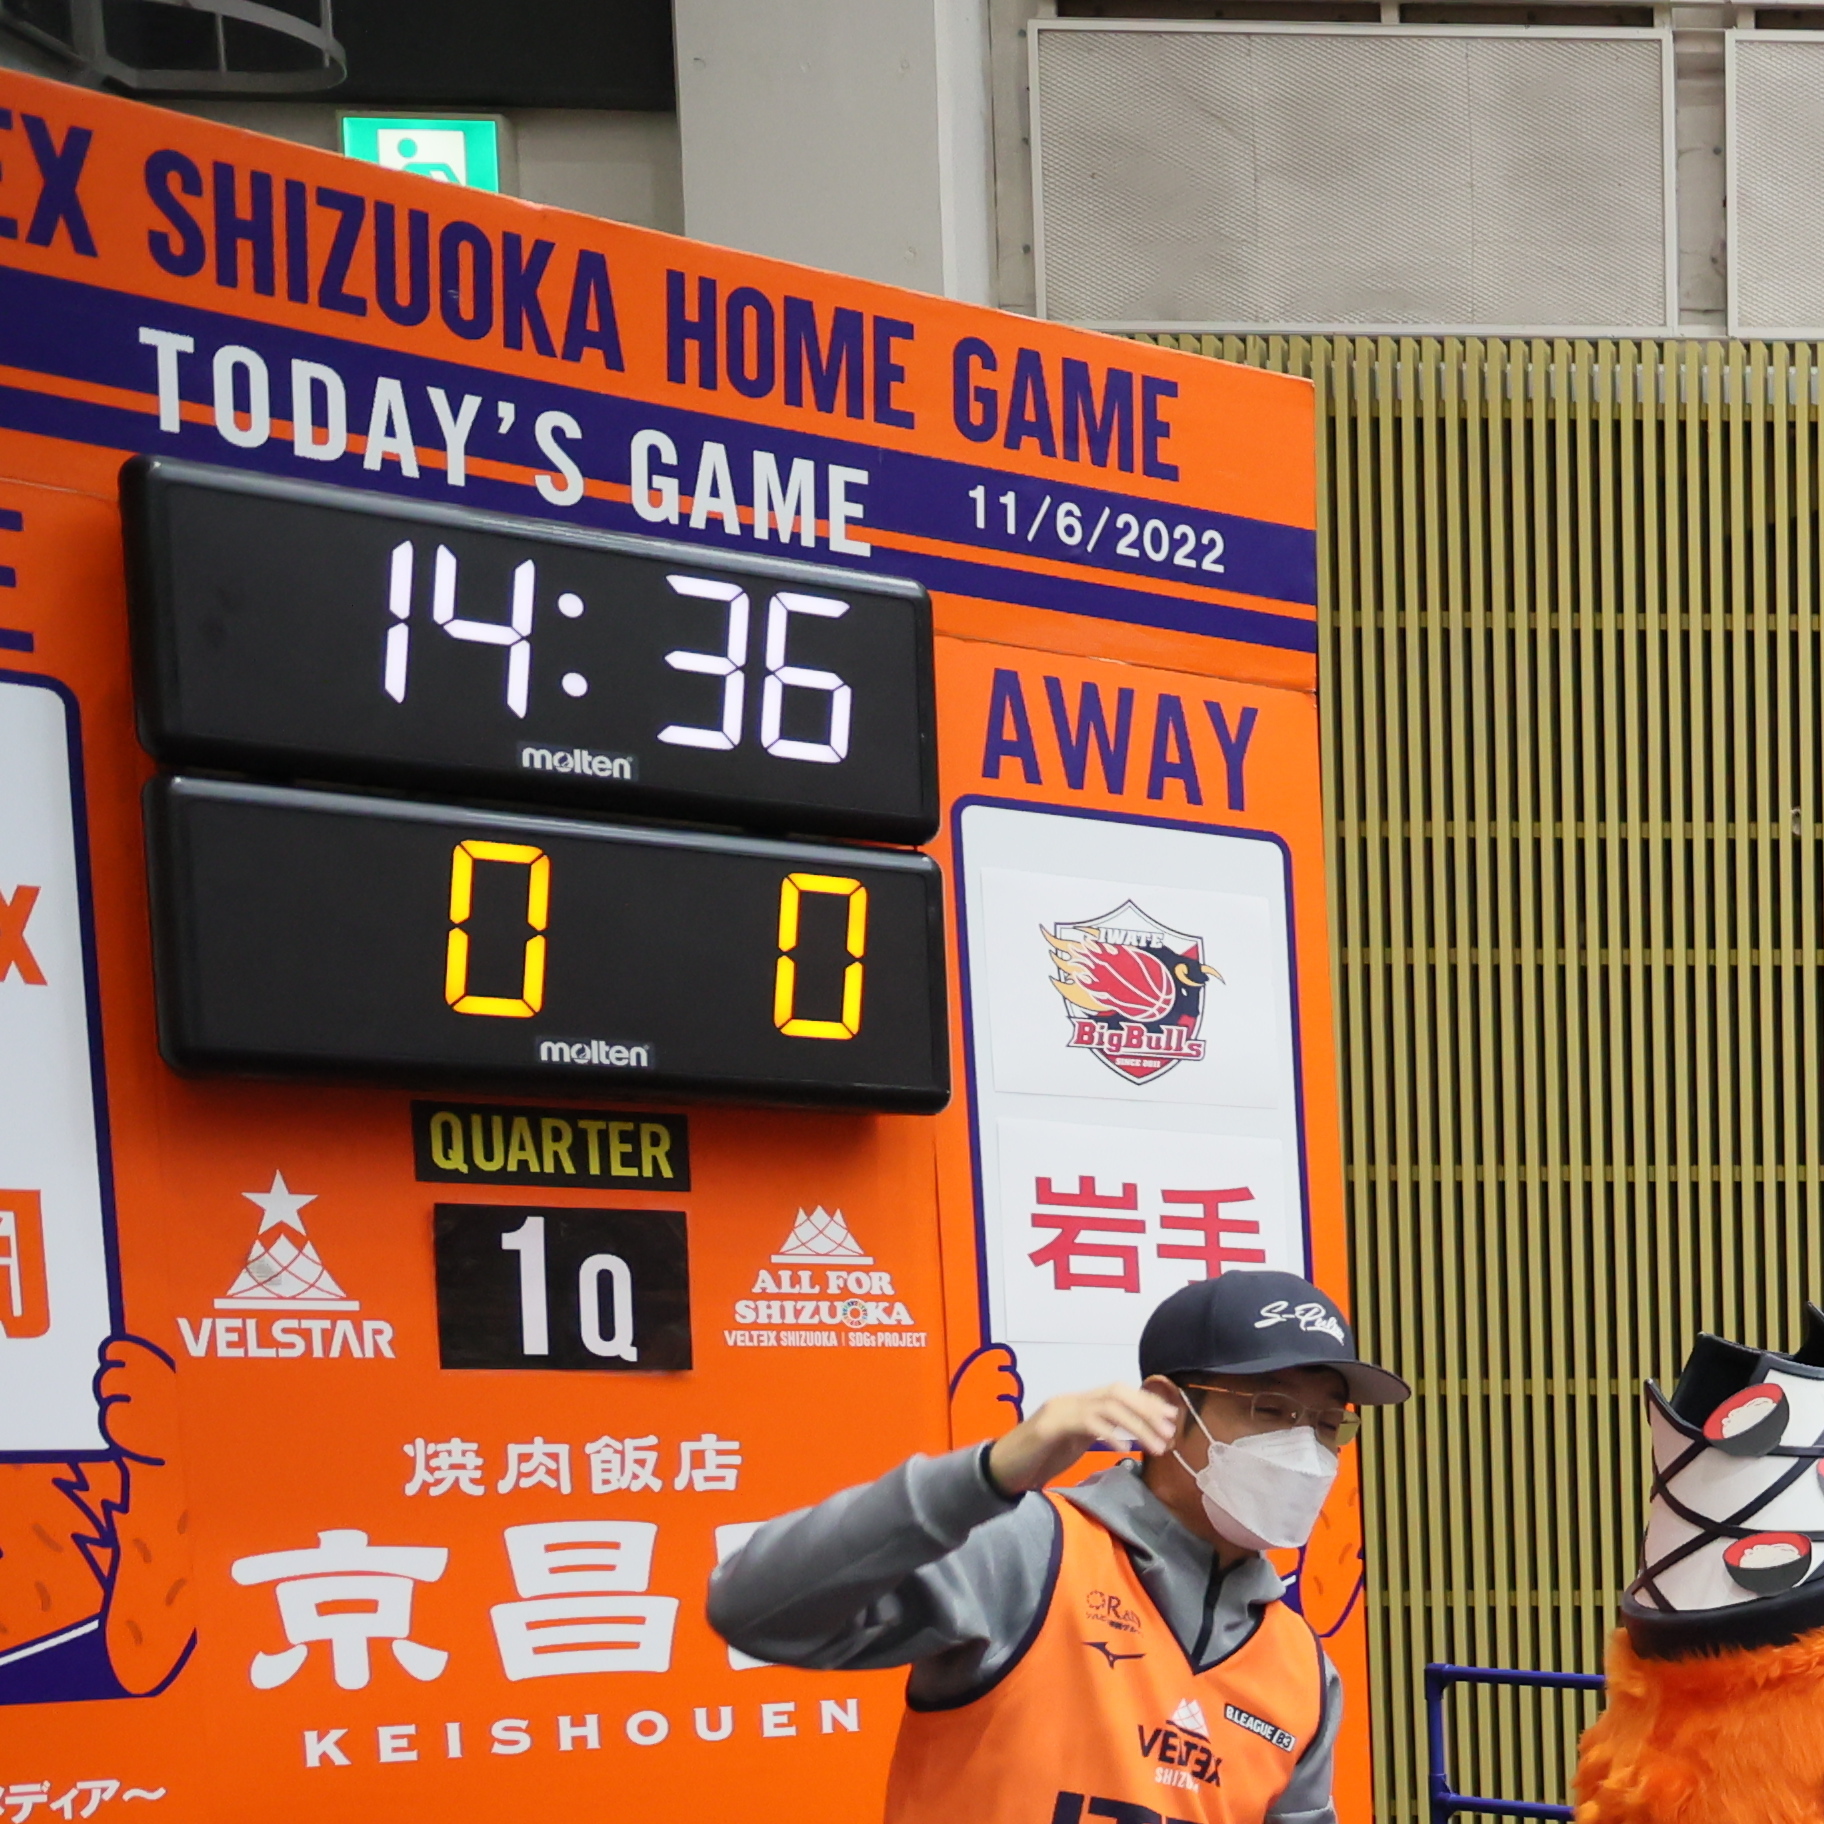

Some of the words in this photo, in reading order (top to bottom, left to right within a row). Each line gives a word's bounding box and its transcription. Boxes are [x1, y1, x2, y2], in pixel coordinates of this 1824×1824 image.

[144, 149, 625, 374] SHIZUOKA
[665, 268, 915, 430] HOME
[952, 336, 1180, 483] GAME
[138, 327, 585, 507] TODAY'S
[630, 429, 872, 559] GAME
[969, 485, 1226, 575] 11/6/2022
[384, 541, 852, 763] 14:36
[521, 745, 634, 781] molten
[981, 667, 1258, 812] AWAY
[444, 839, 551, 1019] 0
[773, 873, 868, 1040] 0
[1099, 928, 1165, 949] IWATE
[539, 1039, 650, 1069] molten
[1072, 1019, 1204, 1058] BigBulls
[429, 1111, 675, 1179] QUARTER
[1027, 1175, 1267, 1295] 岩手
[734, 1298, 915, 1329] SHIZUOKA
[752, 1269, 820, 1295] ALL
[826, 1270, 896, 1296] FOR
[176, 1316, 396, 1360] VELSTAR
[780, 1331, 838, 1347] SHIZUOKA
[877, 1332, 927, 1348] PROJECT
[403, 1433, 743, 1497] 焼肉飯店
[231, 1519, 772, 1690] 京昌
[303, 1698, 861, 1768] KEISHOUEN
[1276, 1731, 1295, 1749] B3
